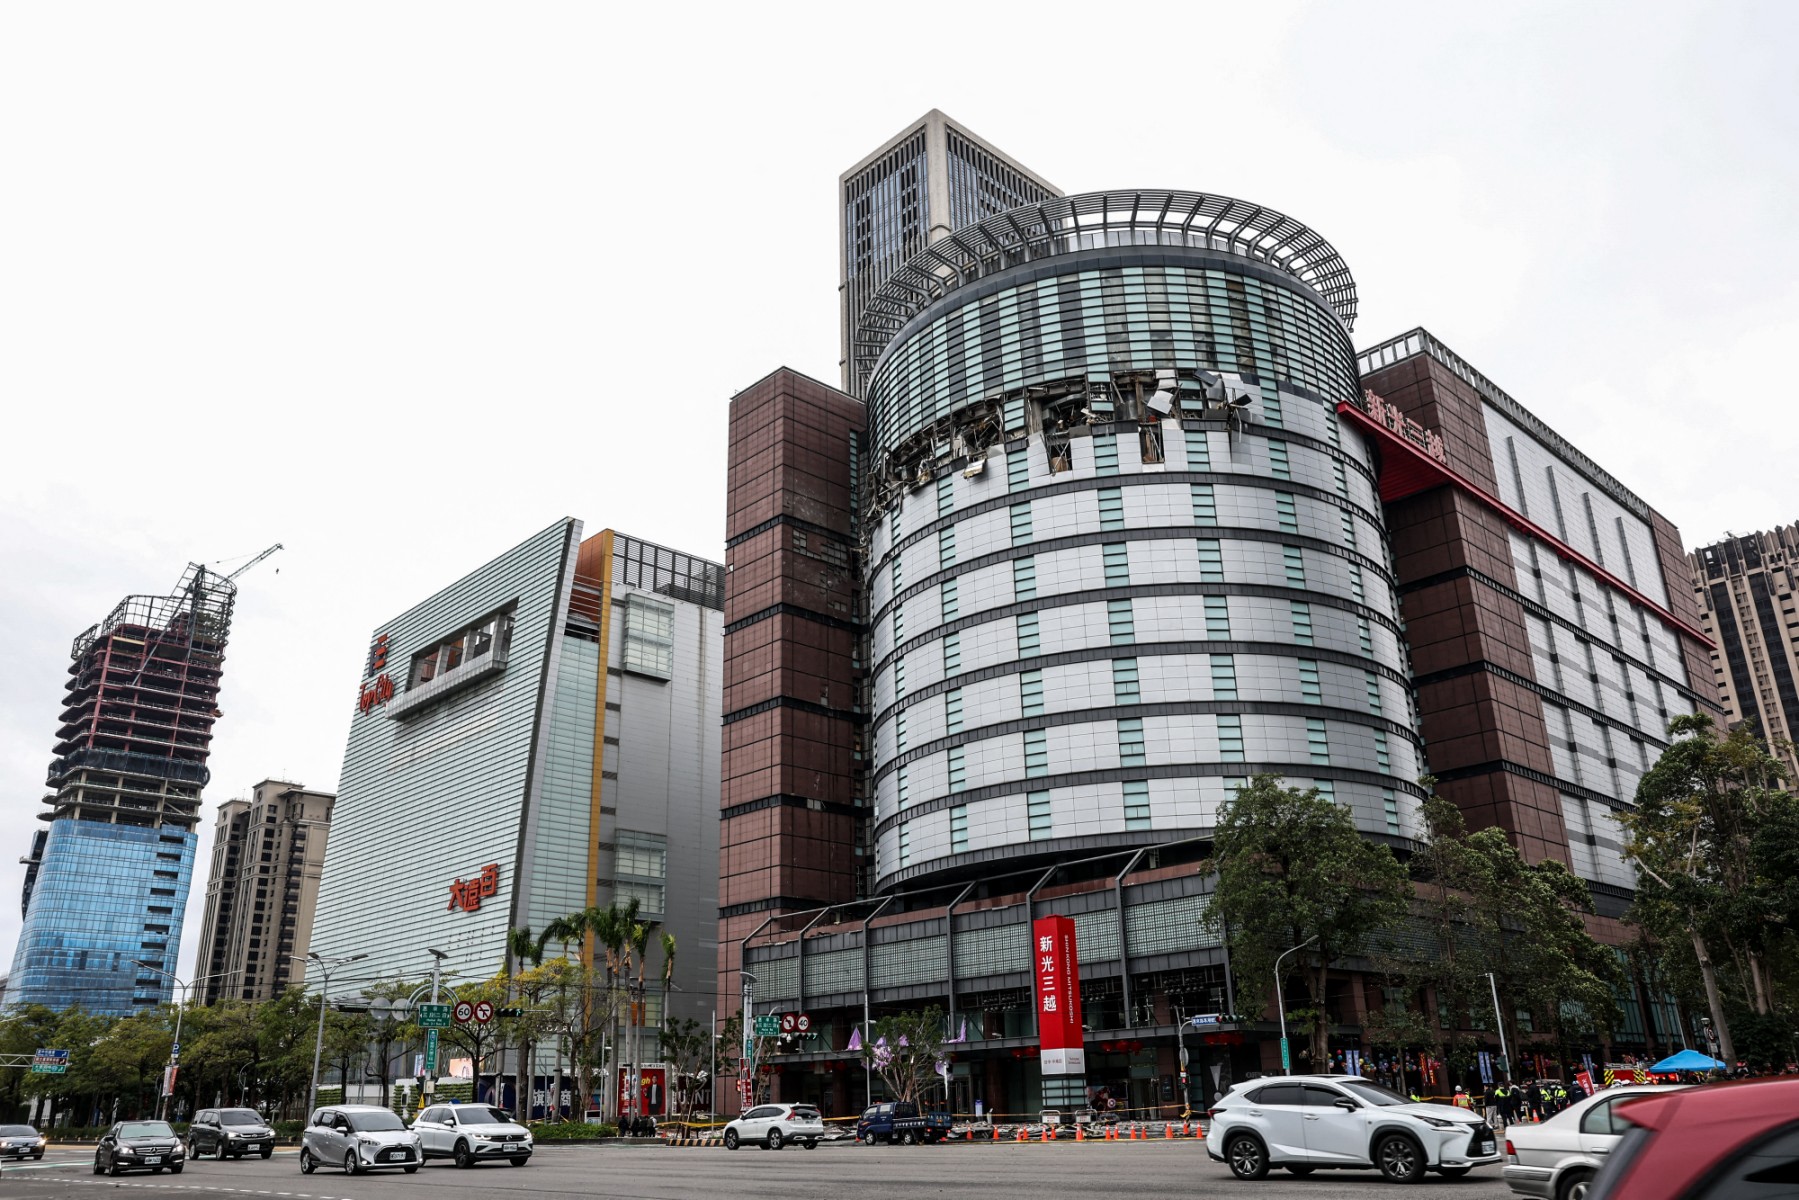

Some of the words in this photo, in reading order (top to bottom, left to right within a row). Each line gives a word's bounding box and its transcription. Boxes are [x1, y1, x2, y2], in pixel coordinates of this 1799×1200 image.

[1364, 389, 1446, 464] 新光三越
[359, 682, 376, 717] Top
[374, 673, 394, 707] City
[447, 863, 498, 912] 大遠百
[1040, 936, 1057, 1012] 新光三越
[457, 1008, 470, 1016] 60
[1066, 976, 1074, 1024] MITSUKOSHI
